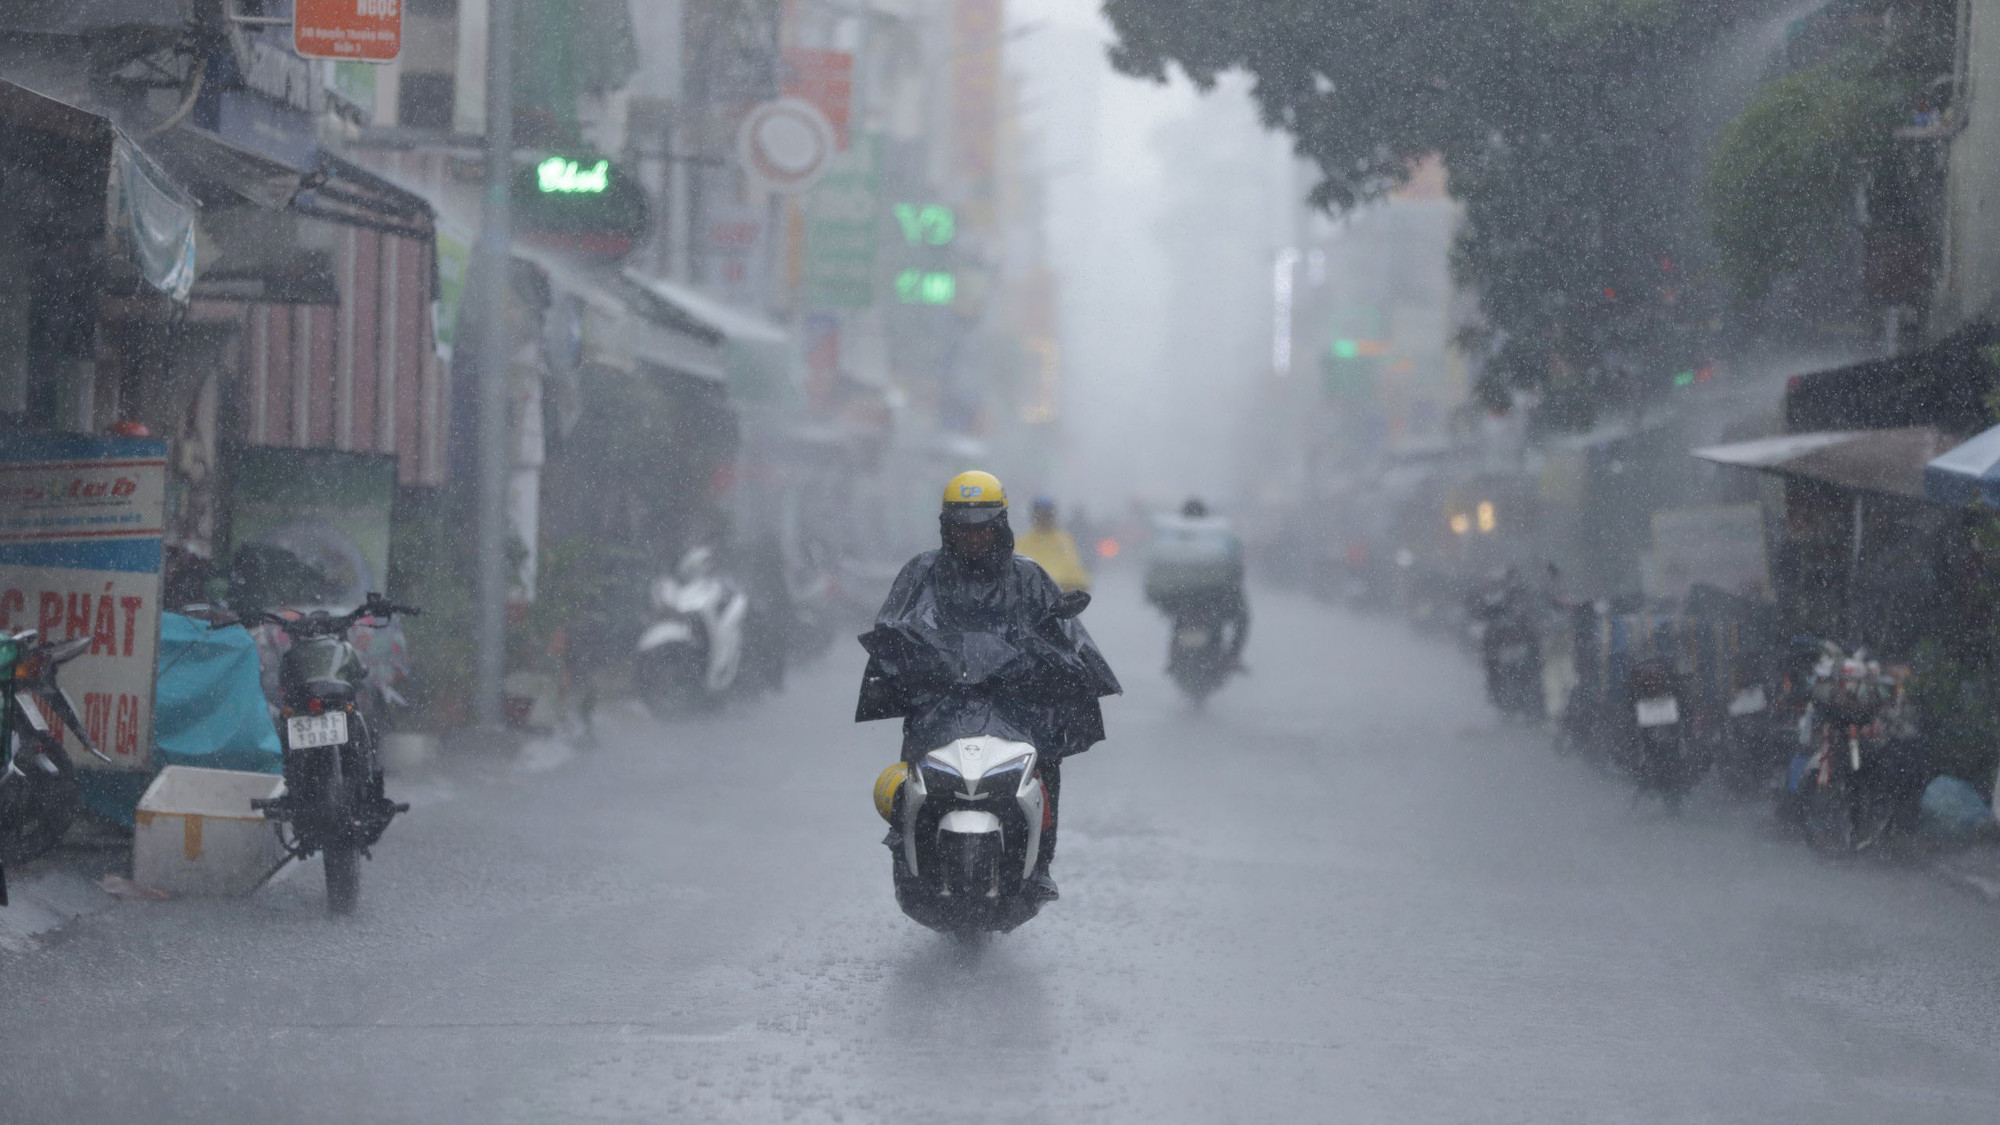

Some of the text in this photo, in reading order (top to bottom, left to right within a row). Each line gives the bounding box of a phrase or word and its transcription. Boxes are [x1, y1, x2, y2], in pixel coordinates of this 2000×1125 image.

[960, 485, 982, 498] be
[38, 581, 142, 656] PHÁT
[116, 692, 139, 755] GA
